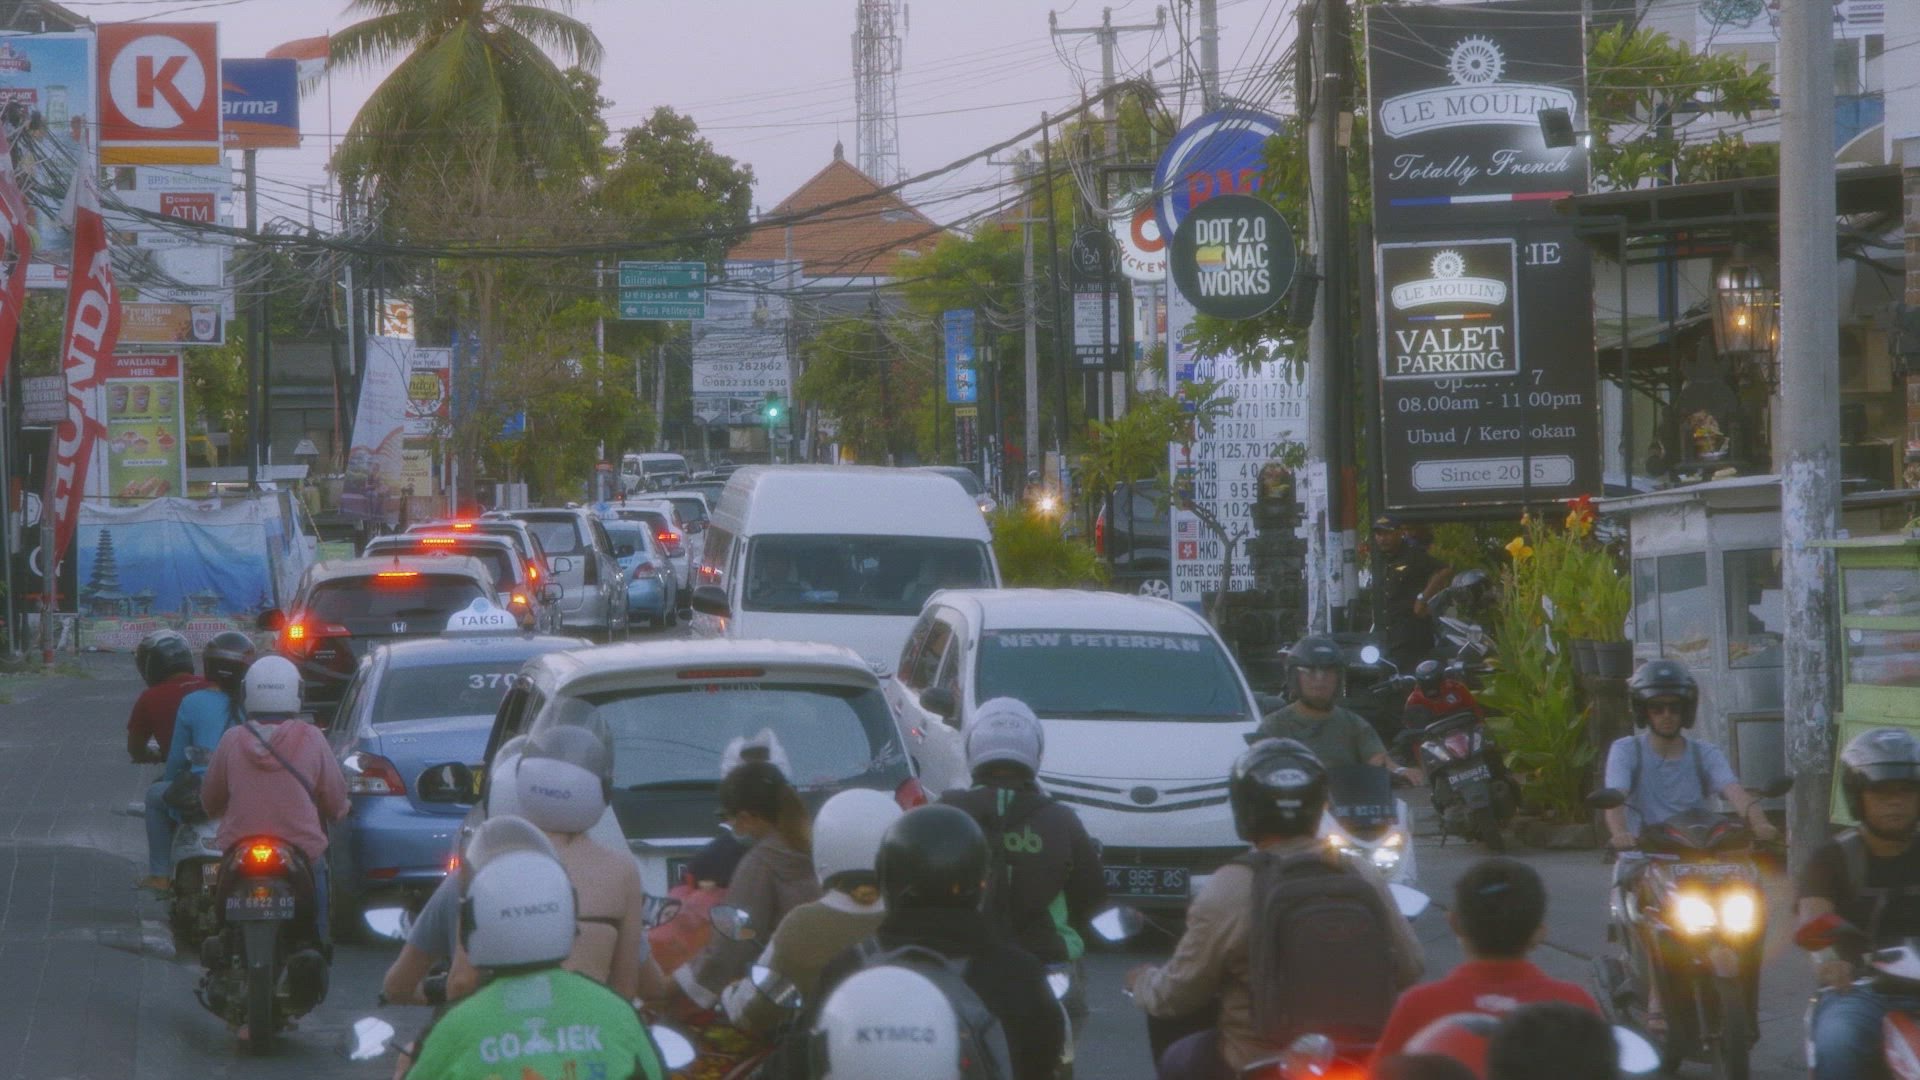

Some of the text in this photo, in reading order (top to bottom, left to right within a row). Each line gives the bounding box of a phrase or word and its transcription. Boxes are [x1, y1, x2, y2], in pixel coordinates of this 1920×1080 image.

[1400, 93, 1558, 125] LE MOULIN
[1388, 149, 1573, 186] Totally French
[171, 206, 209, 221] ATM
[1195, 216, 1266, 245] DOT 2.0
[1225, 244, 1269, 269] MAC
[1524, 242, 1561, 265] IE
[1197, 269, 1270, 297] WORKS
[1403, 282, 1496, 300] LE MOULIN
[1396, 325, 1505, 354] VALET
[117, 357, 168, 367] AVAILABLE
[1396, 351, 1505, 374] PARKING
[130, 367, 155, 377] HERE
[1221, 382, 1302, 400] 18670 17970
[1265, 402, 1301, 418] 15770
[1398, 395, 1479, 413] 08.00am
[1502, 391, 1582, 410] 1100pm
[1220, 422, 1256, 439] 13720
[1407, 428, 1457, 444] Ubud
[1479, 424, 1577, 441] Kerookan
[1198, 441, 1217, 460] JPY
[1219, 442, 1261, 459] 125.70
[1198, 461, 1218, 480] THB
[1440, 462, 1546, 483] Since 205
[1198, 481, 1218, 500] NZD
[1200, 541, 1218, 560] HKD
[1176, 564, 1204, 577] OTHER
[1181, 580, 1192, 594] ON
[1194, 579, 1212, 593] THE
[1214, 579, 1243, 592] BRD
[460, 615, 505, 626] TAKSI
[999, 632, 1201, 652] NEW PETERPAN
[1128, 869, 1157, 887] 965
